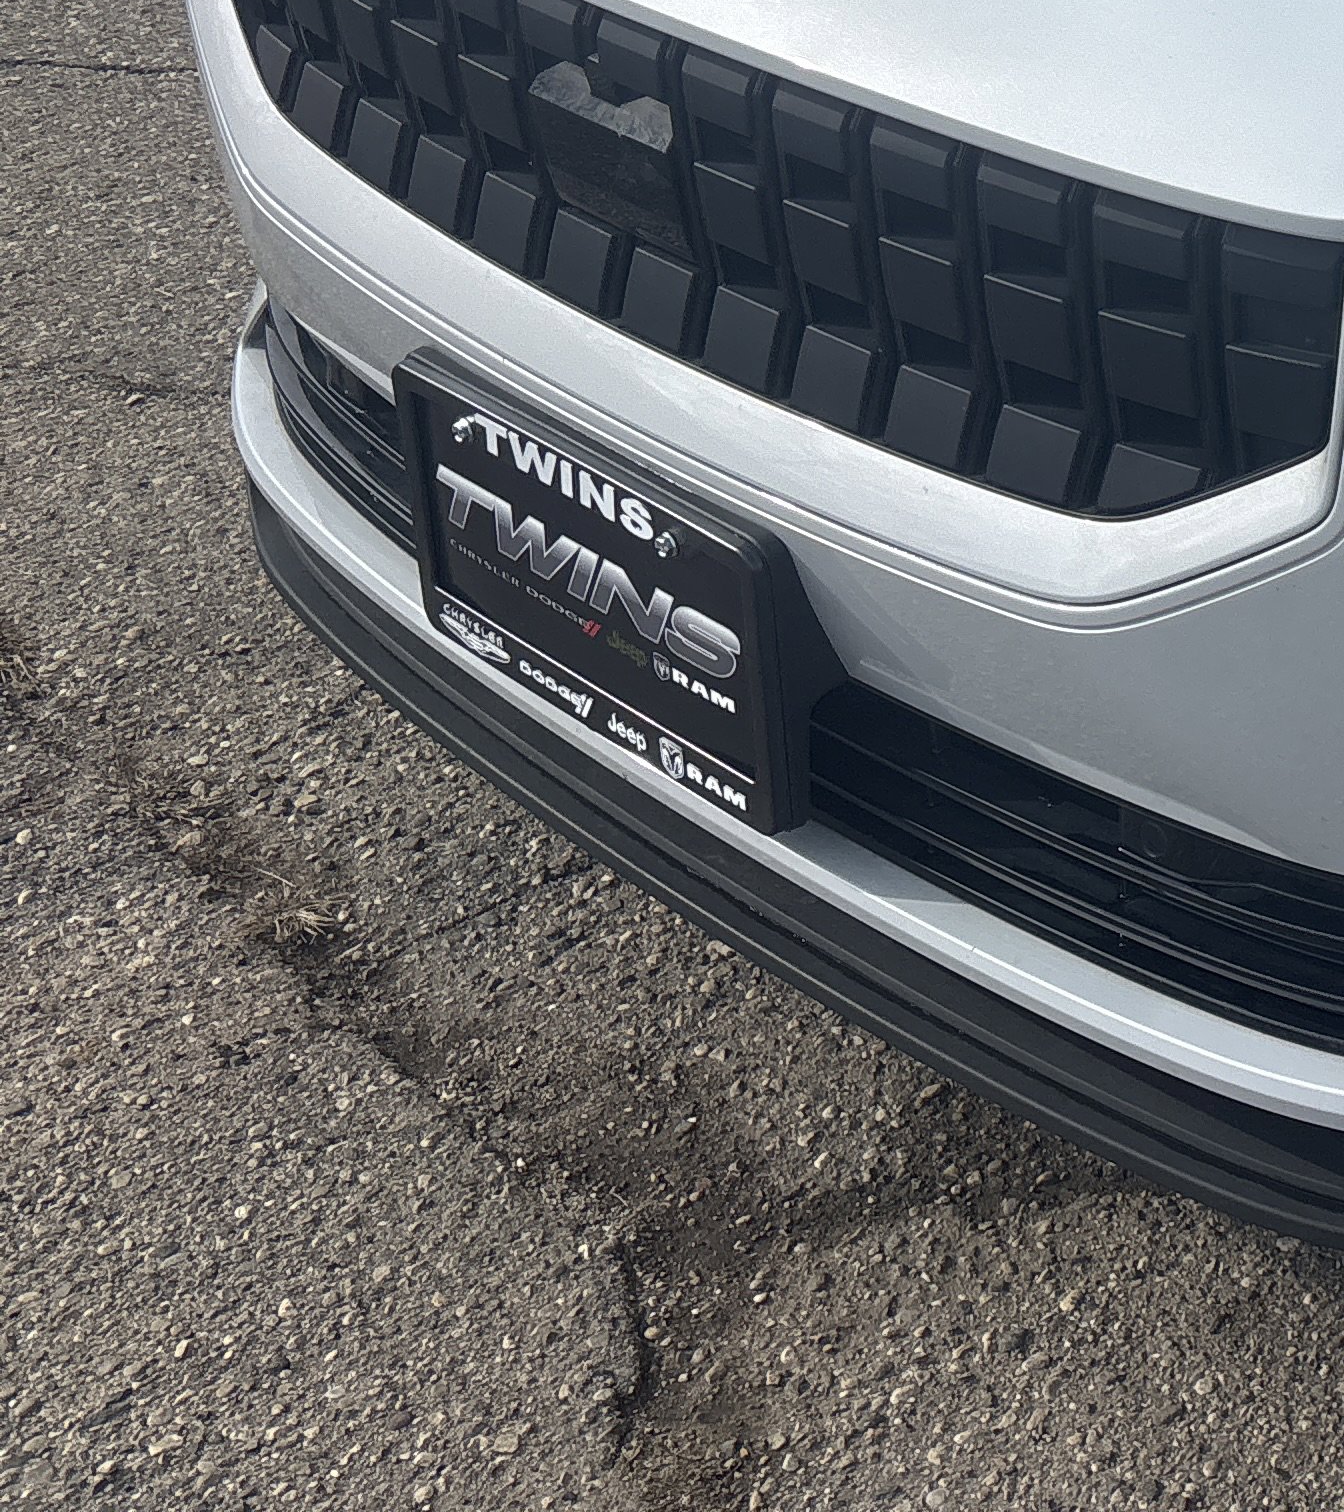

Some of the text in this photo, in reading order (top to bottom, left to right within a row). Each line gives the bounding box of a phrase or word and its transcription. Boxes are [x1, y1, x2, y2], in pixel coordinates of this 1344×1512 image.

[435, 463, 741, 679] TWINS
[474, 412, 654, 541] TWINS
[442, 603, 504, 649] CHRYSLER
[607, 712, 648, 752] Jeep
[686, 762, 747, 812] RAM
[449, 538, 520, 588] CHRYSLER
[671, 666, 736, 714] RAM
